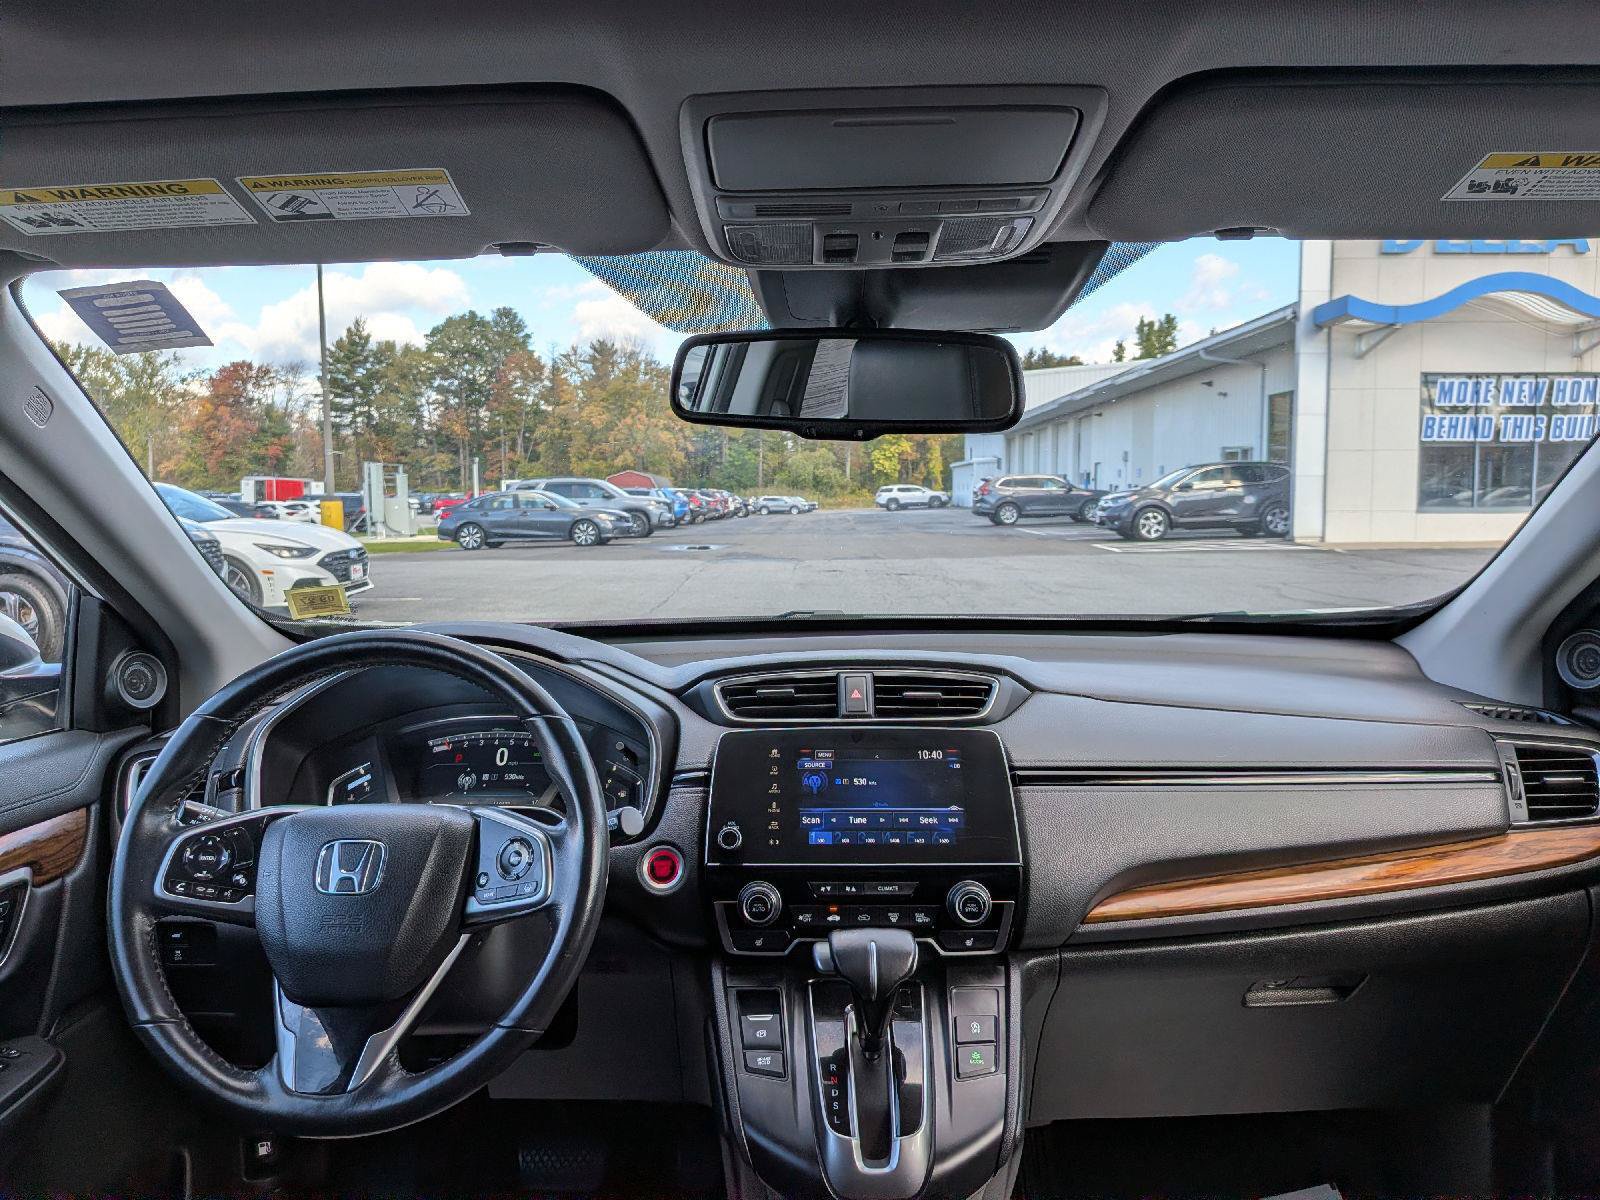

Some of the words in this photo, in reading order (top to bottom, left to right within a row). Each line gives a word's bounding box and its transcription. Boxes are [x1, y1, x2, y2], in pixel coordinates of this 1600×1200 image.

[47, 183, 190, 202] WARNING
[1435, 378, 1494, 406] MORE
[1501, 378, 1548, 406] NEW
[1421, 414, 1494, 441] BEHIND
[1500, 414, 1547, 441] THIS
[496, 747, 509, 766] 0
[917, 750, 943, 760] 10:40
[853, 777, 867, 786] 530
[802, 816, 821, 824] Scan
[848, 816, 868, 824] Tune
[919, 816, 939, 824] Seek
[830, 1063, 837, 1071] R
[830, 1075, 838, 1085] N
[831, 1089, 839, 1097] D
[832, 1101, 839, 1110] S
[834, 1115, 841, 1124] L
